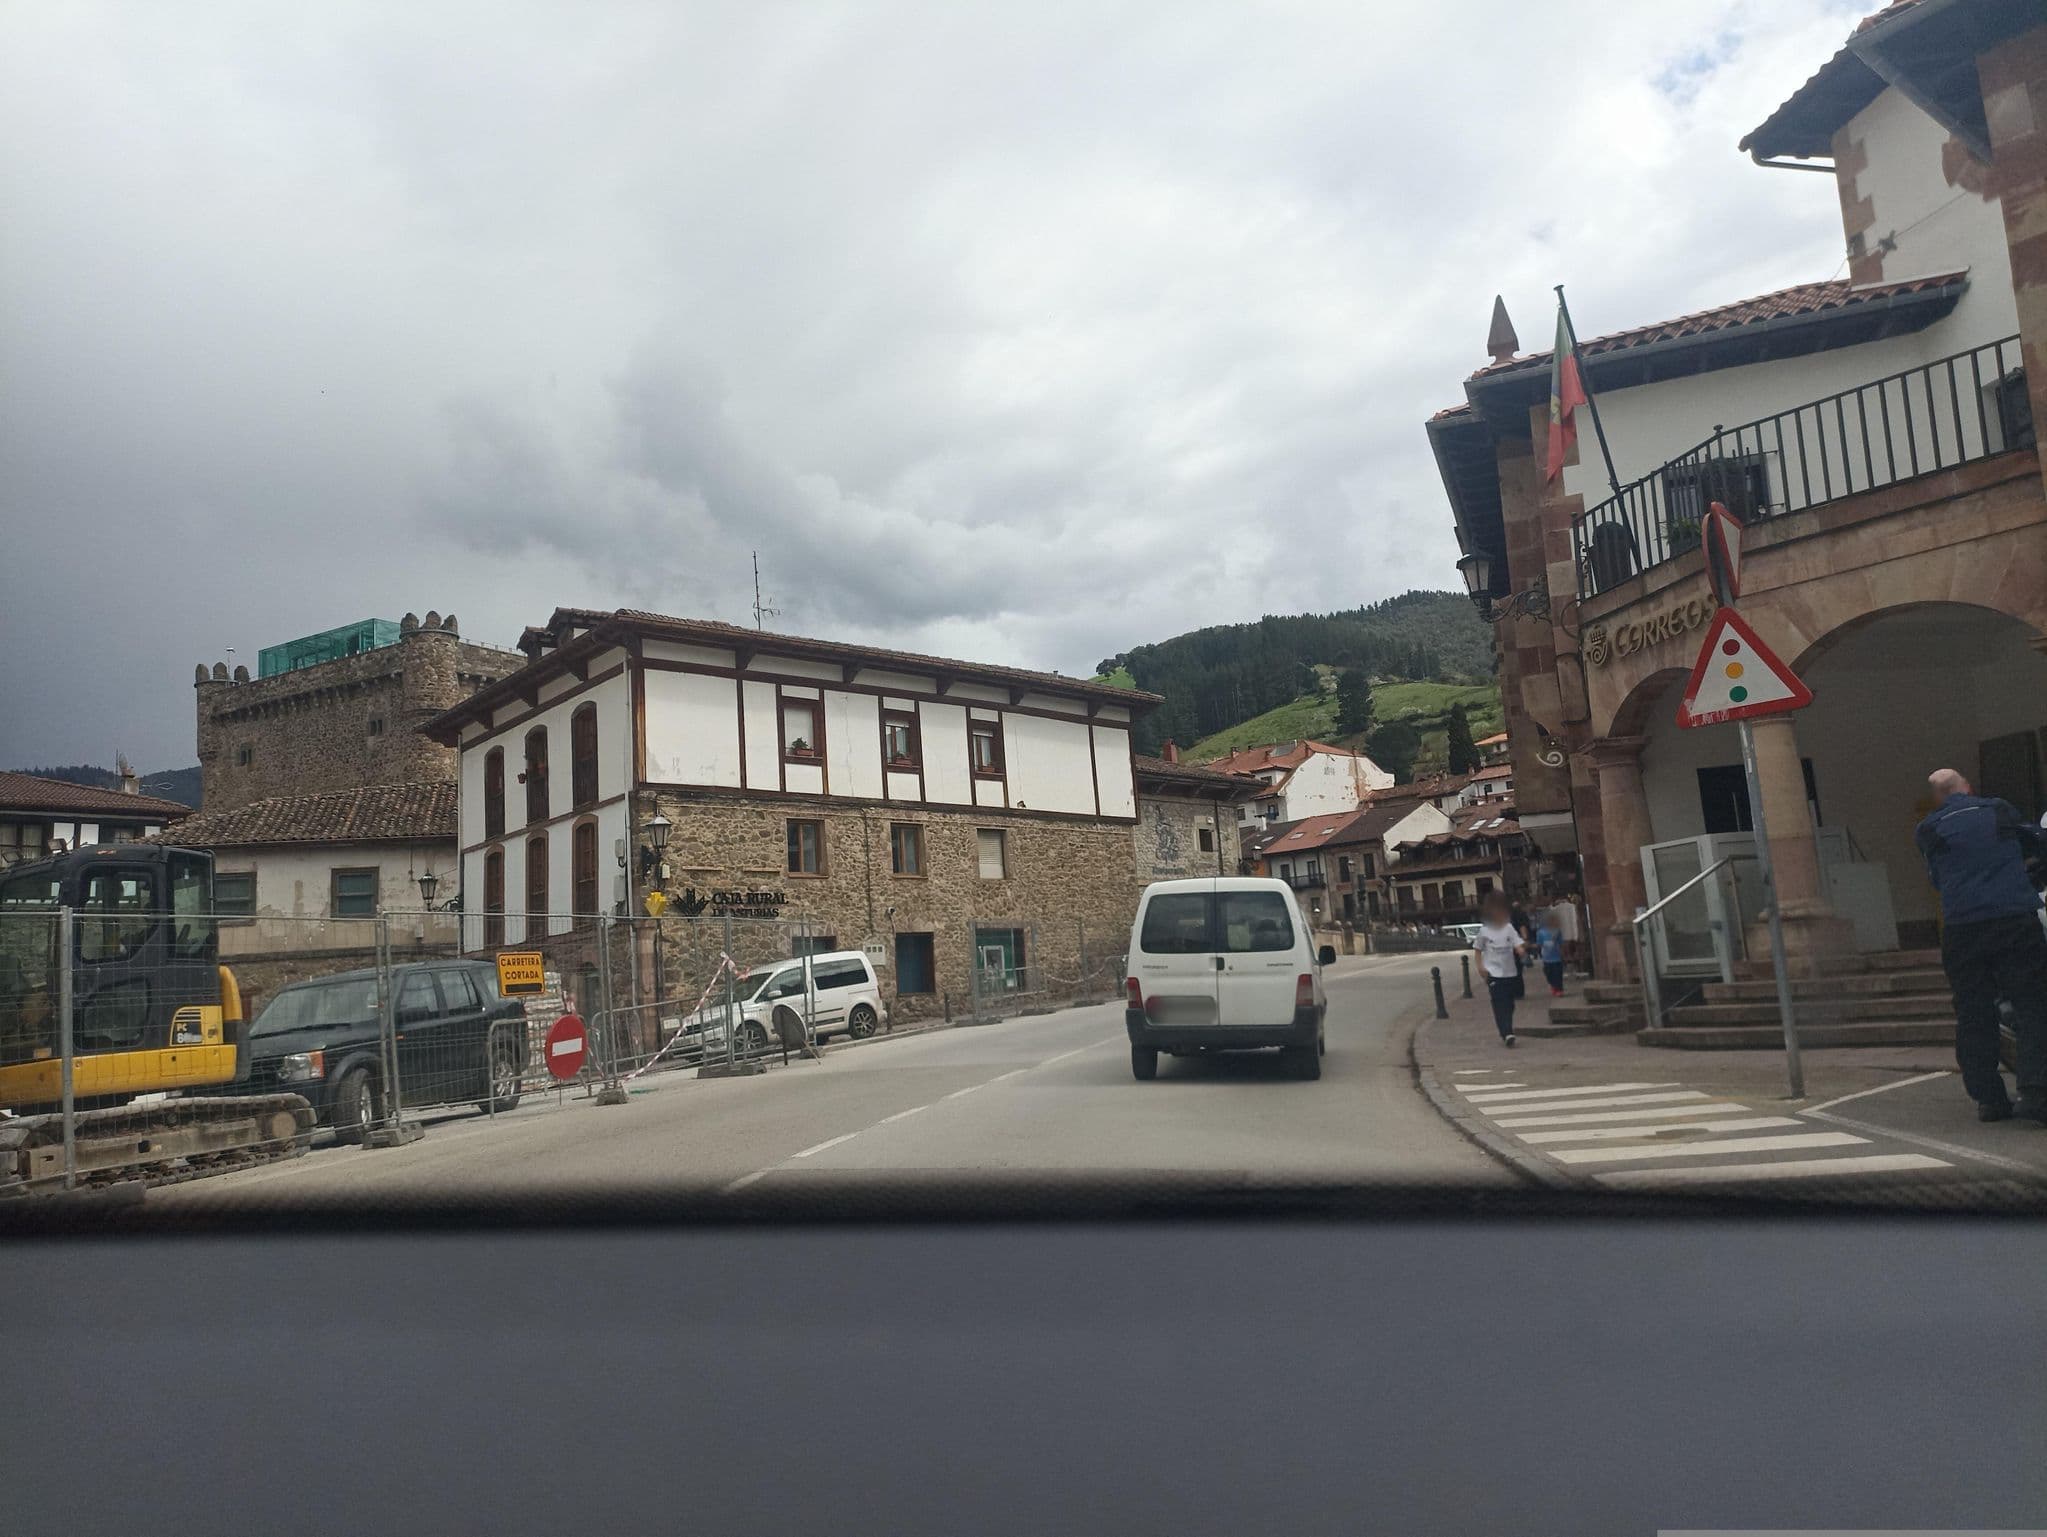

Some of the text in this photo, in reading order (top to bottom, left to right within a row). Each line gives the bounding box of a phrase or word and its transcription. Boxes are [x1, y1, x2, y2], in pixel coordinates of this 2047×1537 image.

[1613, 594, 1717, 657] CORREOS
[712, 892, 789, 904] CAJA RURAL
[730, 908, 779, 918] ASTURIAS
[500, 957, 540, 966] CARRETERA
[505, 970, 539, 980] CORTADA
